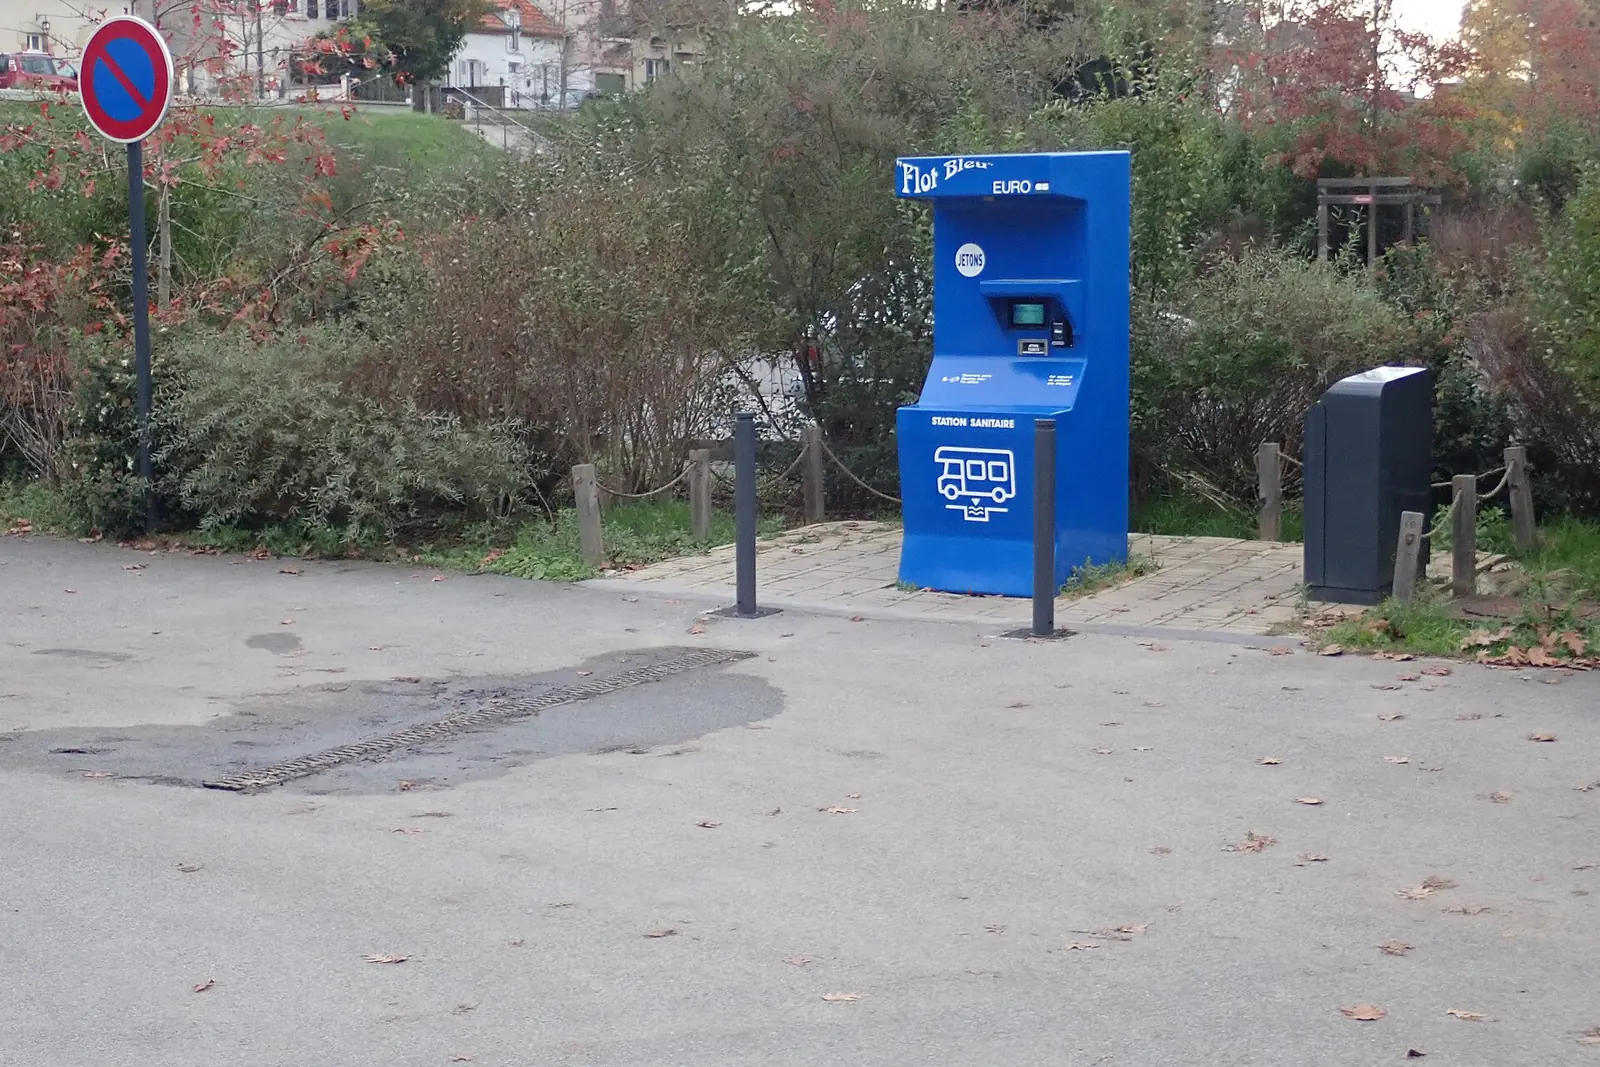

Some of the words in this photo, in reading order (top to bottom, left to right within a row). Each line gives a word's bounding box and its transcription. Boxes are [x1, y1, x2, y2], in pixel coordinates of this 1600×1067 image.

[992, 179, 1031, 194] EURO
[958, 253, 983, 267] JETONS
[931, 416, 967, 427] STATION
[970, 418, 1015, 429] SANITAIRE
